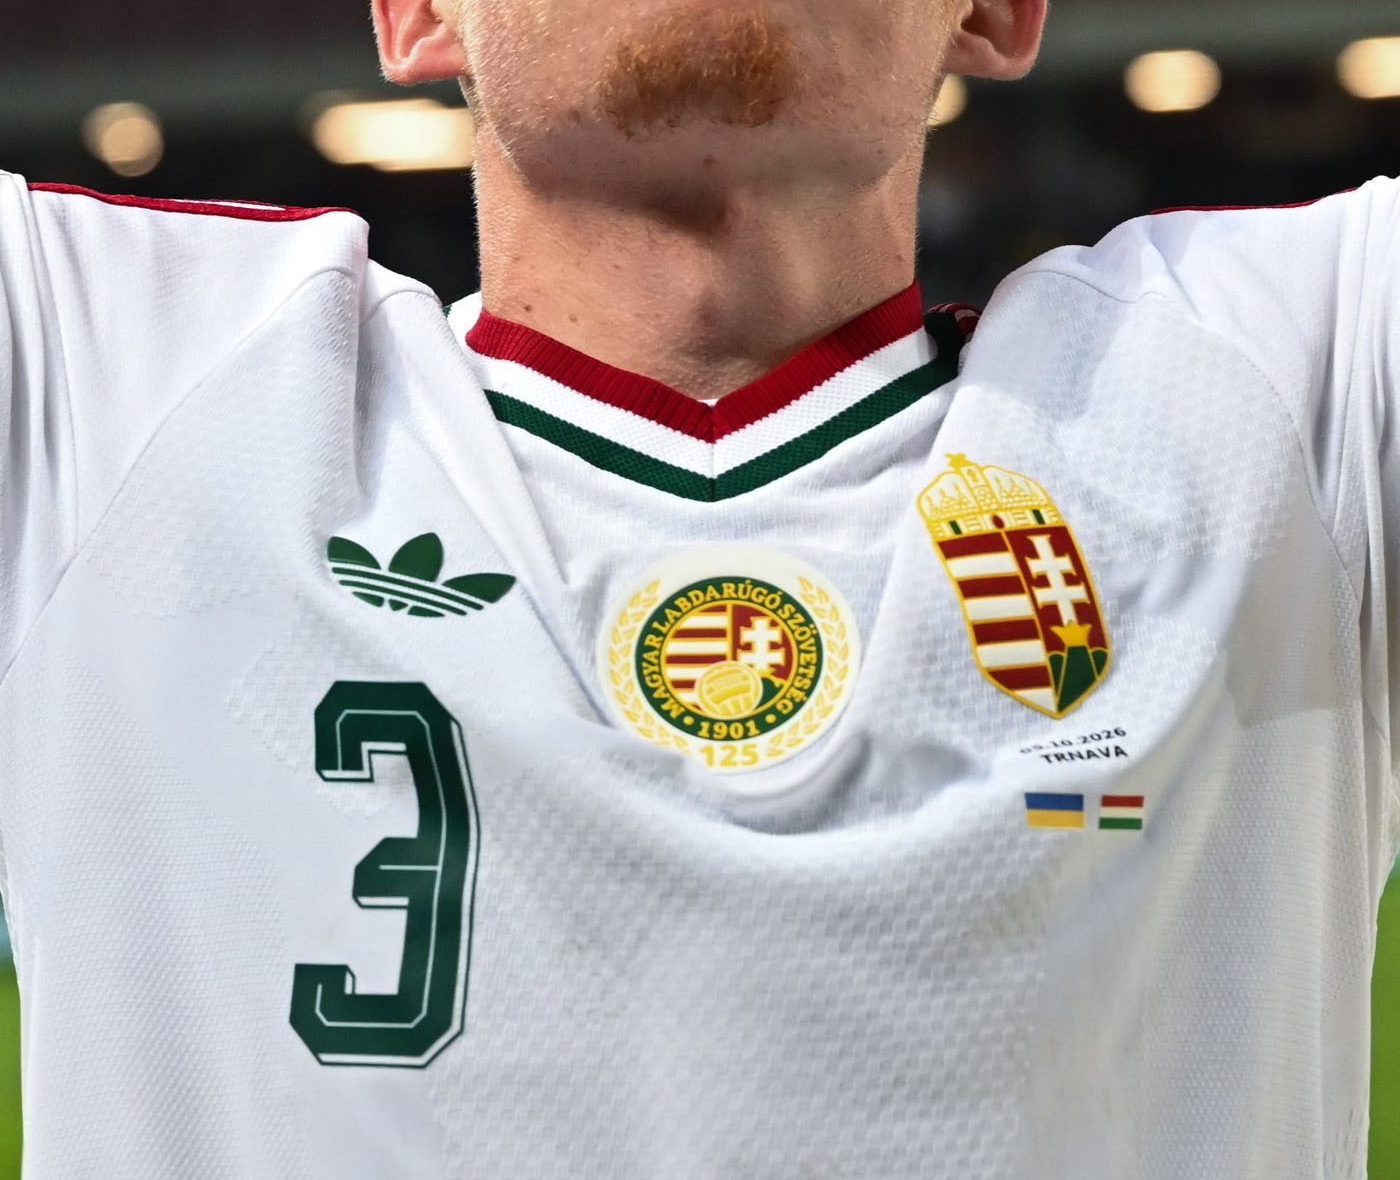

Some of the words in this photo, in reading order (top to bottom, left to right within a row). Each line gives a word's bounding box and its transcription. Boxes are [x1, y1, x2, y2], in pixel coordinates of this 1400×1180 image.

[653, 580, 784, 632] LABDARÚGÓ
[643, 634, 685, 718] MAGYAR
[777, 602, 818, 714] SZÖVETSÉG
[697, 719, 760, 739] 1901
[699, 743, 760, 767] 125
[1041, 745, 1128, 764] TRNAVA
[289, 680, 480, 1069] 3
